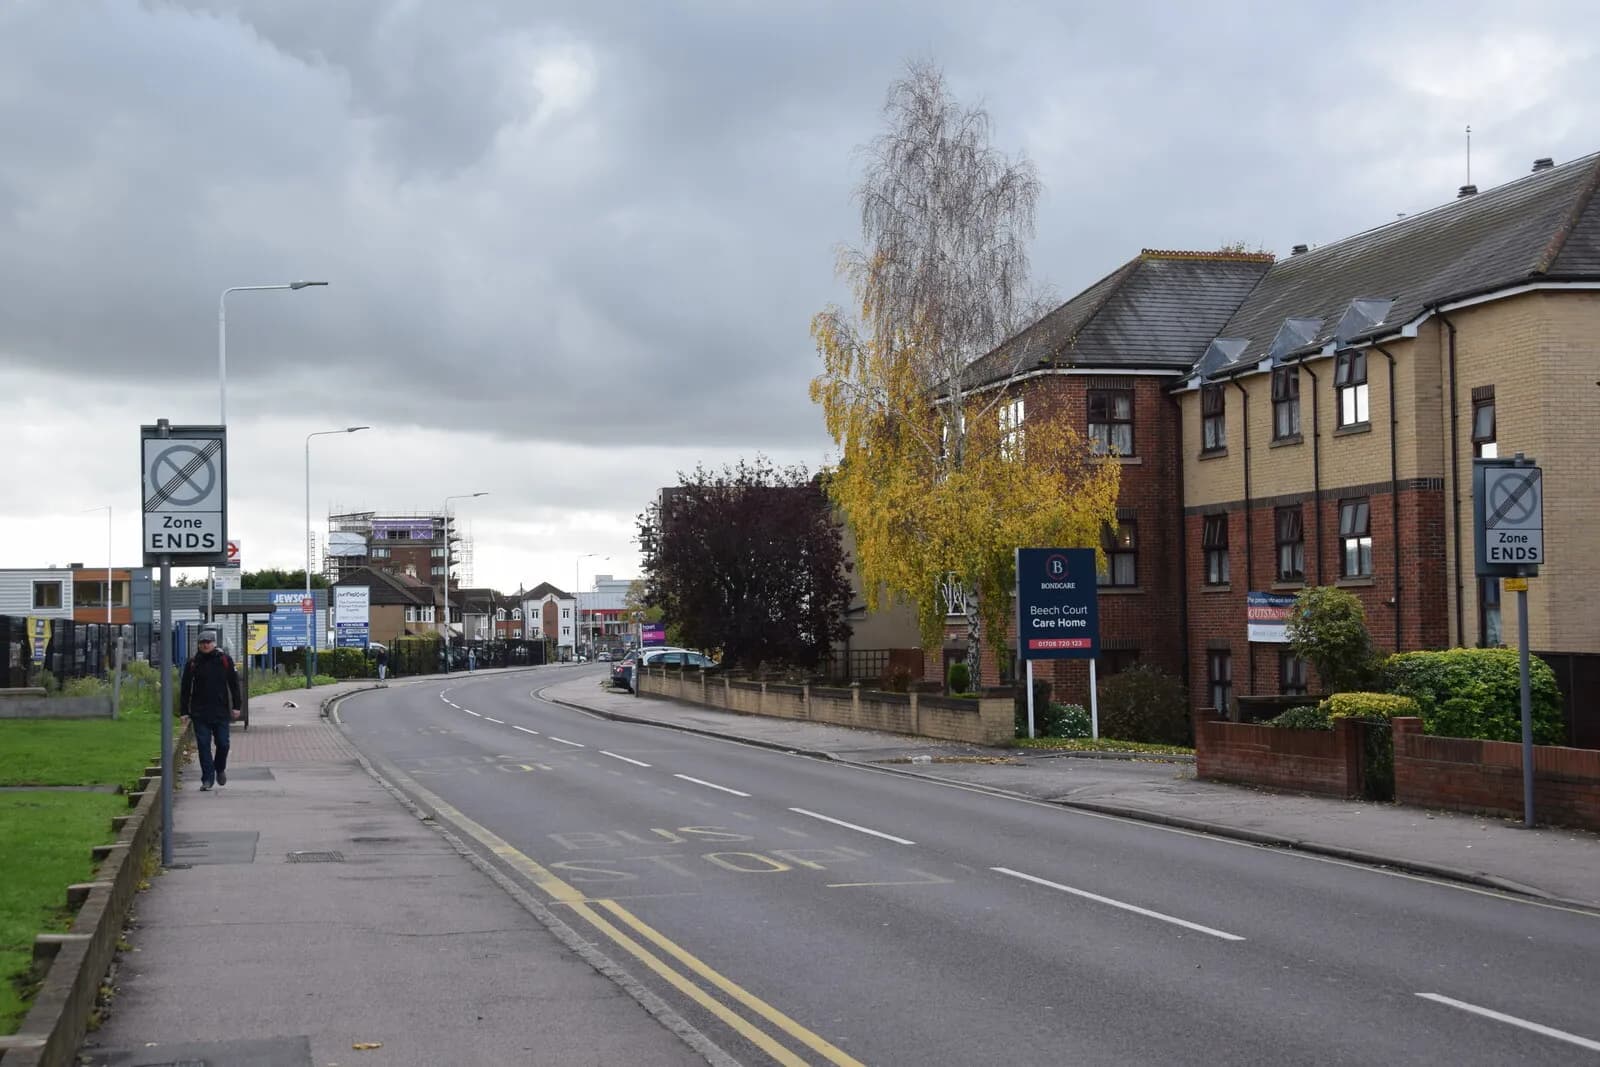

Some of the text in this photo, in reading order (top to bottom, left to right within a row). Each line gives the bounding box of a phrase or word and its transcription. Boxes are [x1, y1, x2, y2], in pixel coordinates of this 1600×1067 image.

[163, 516, 202, 528] Zone
[152, 533, 215, 548] ENDS
[1499, 533, 1528, 543] Zone
[1491, 547, 1537, 560] ENDS
[273, 593, 312, 603] JEWSO
[1030, 605, 1088, 615] Beech Court
[1032, 618, 1087, 628] Care Home
[546, 826, 755, 850] BUS
